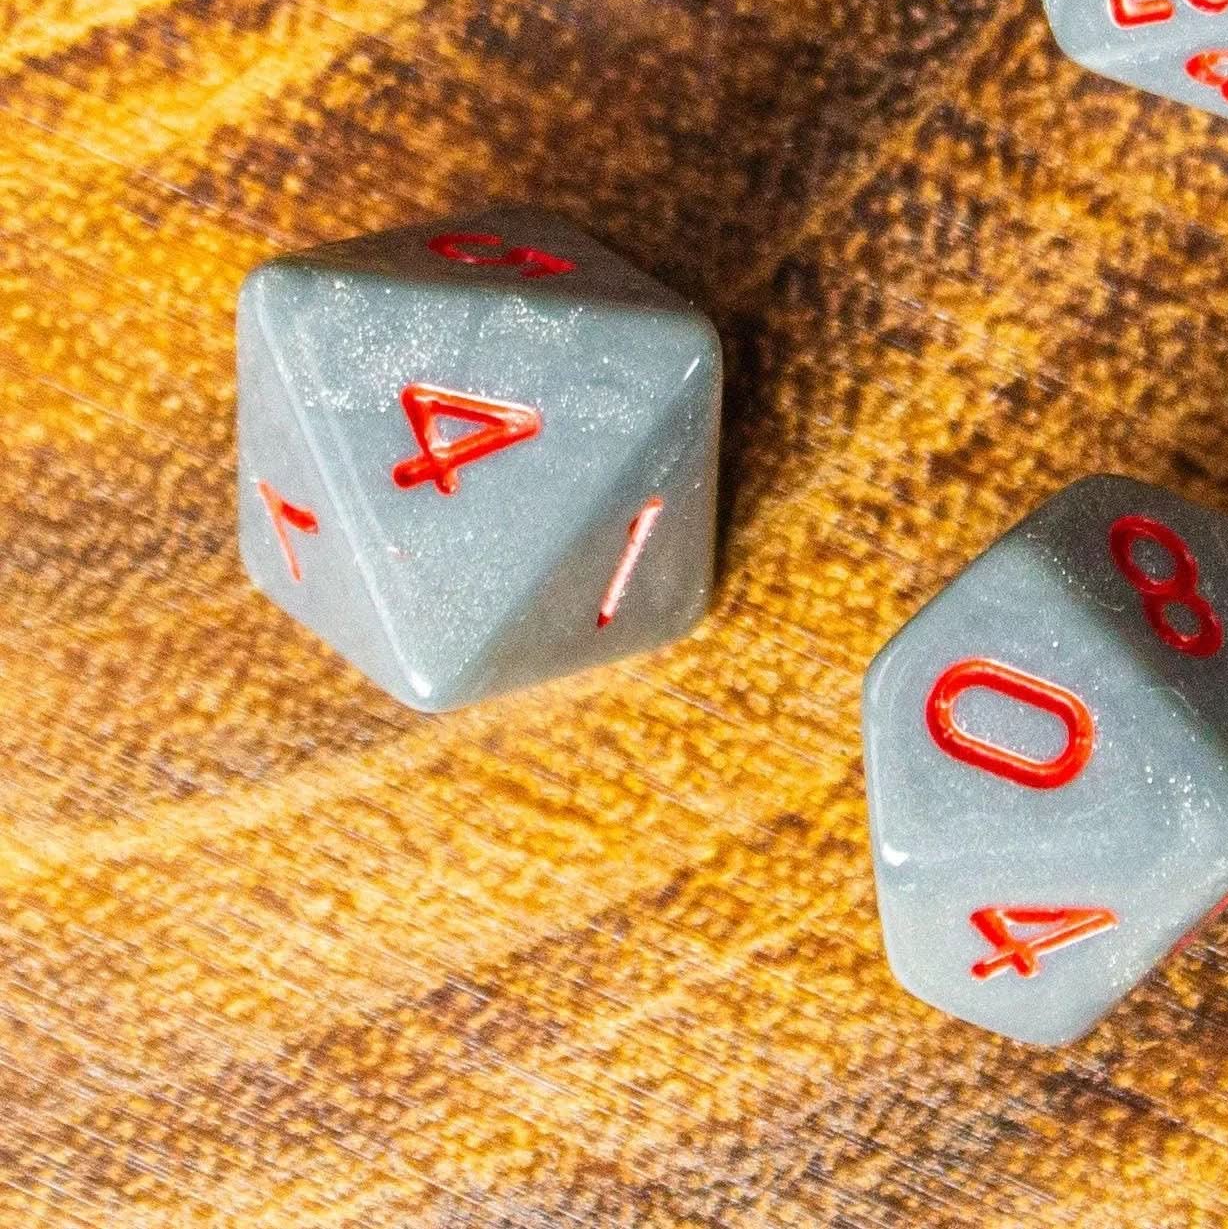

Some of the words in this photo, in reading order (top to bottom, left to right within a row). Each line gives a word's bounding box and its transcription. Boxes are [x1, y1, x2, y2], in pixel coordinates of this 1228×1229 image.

[392, 382, 544, 497] 4
[1109, 513, 1225, 660] 8
[924, 657, 1097, 793] 0
[968, 905, 1120, 981] 4
